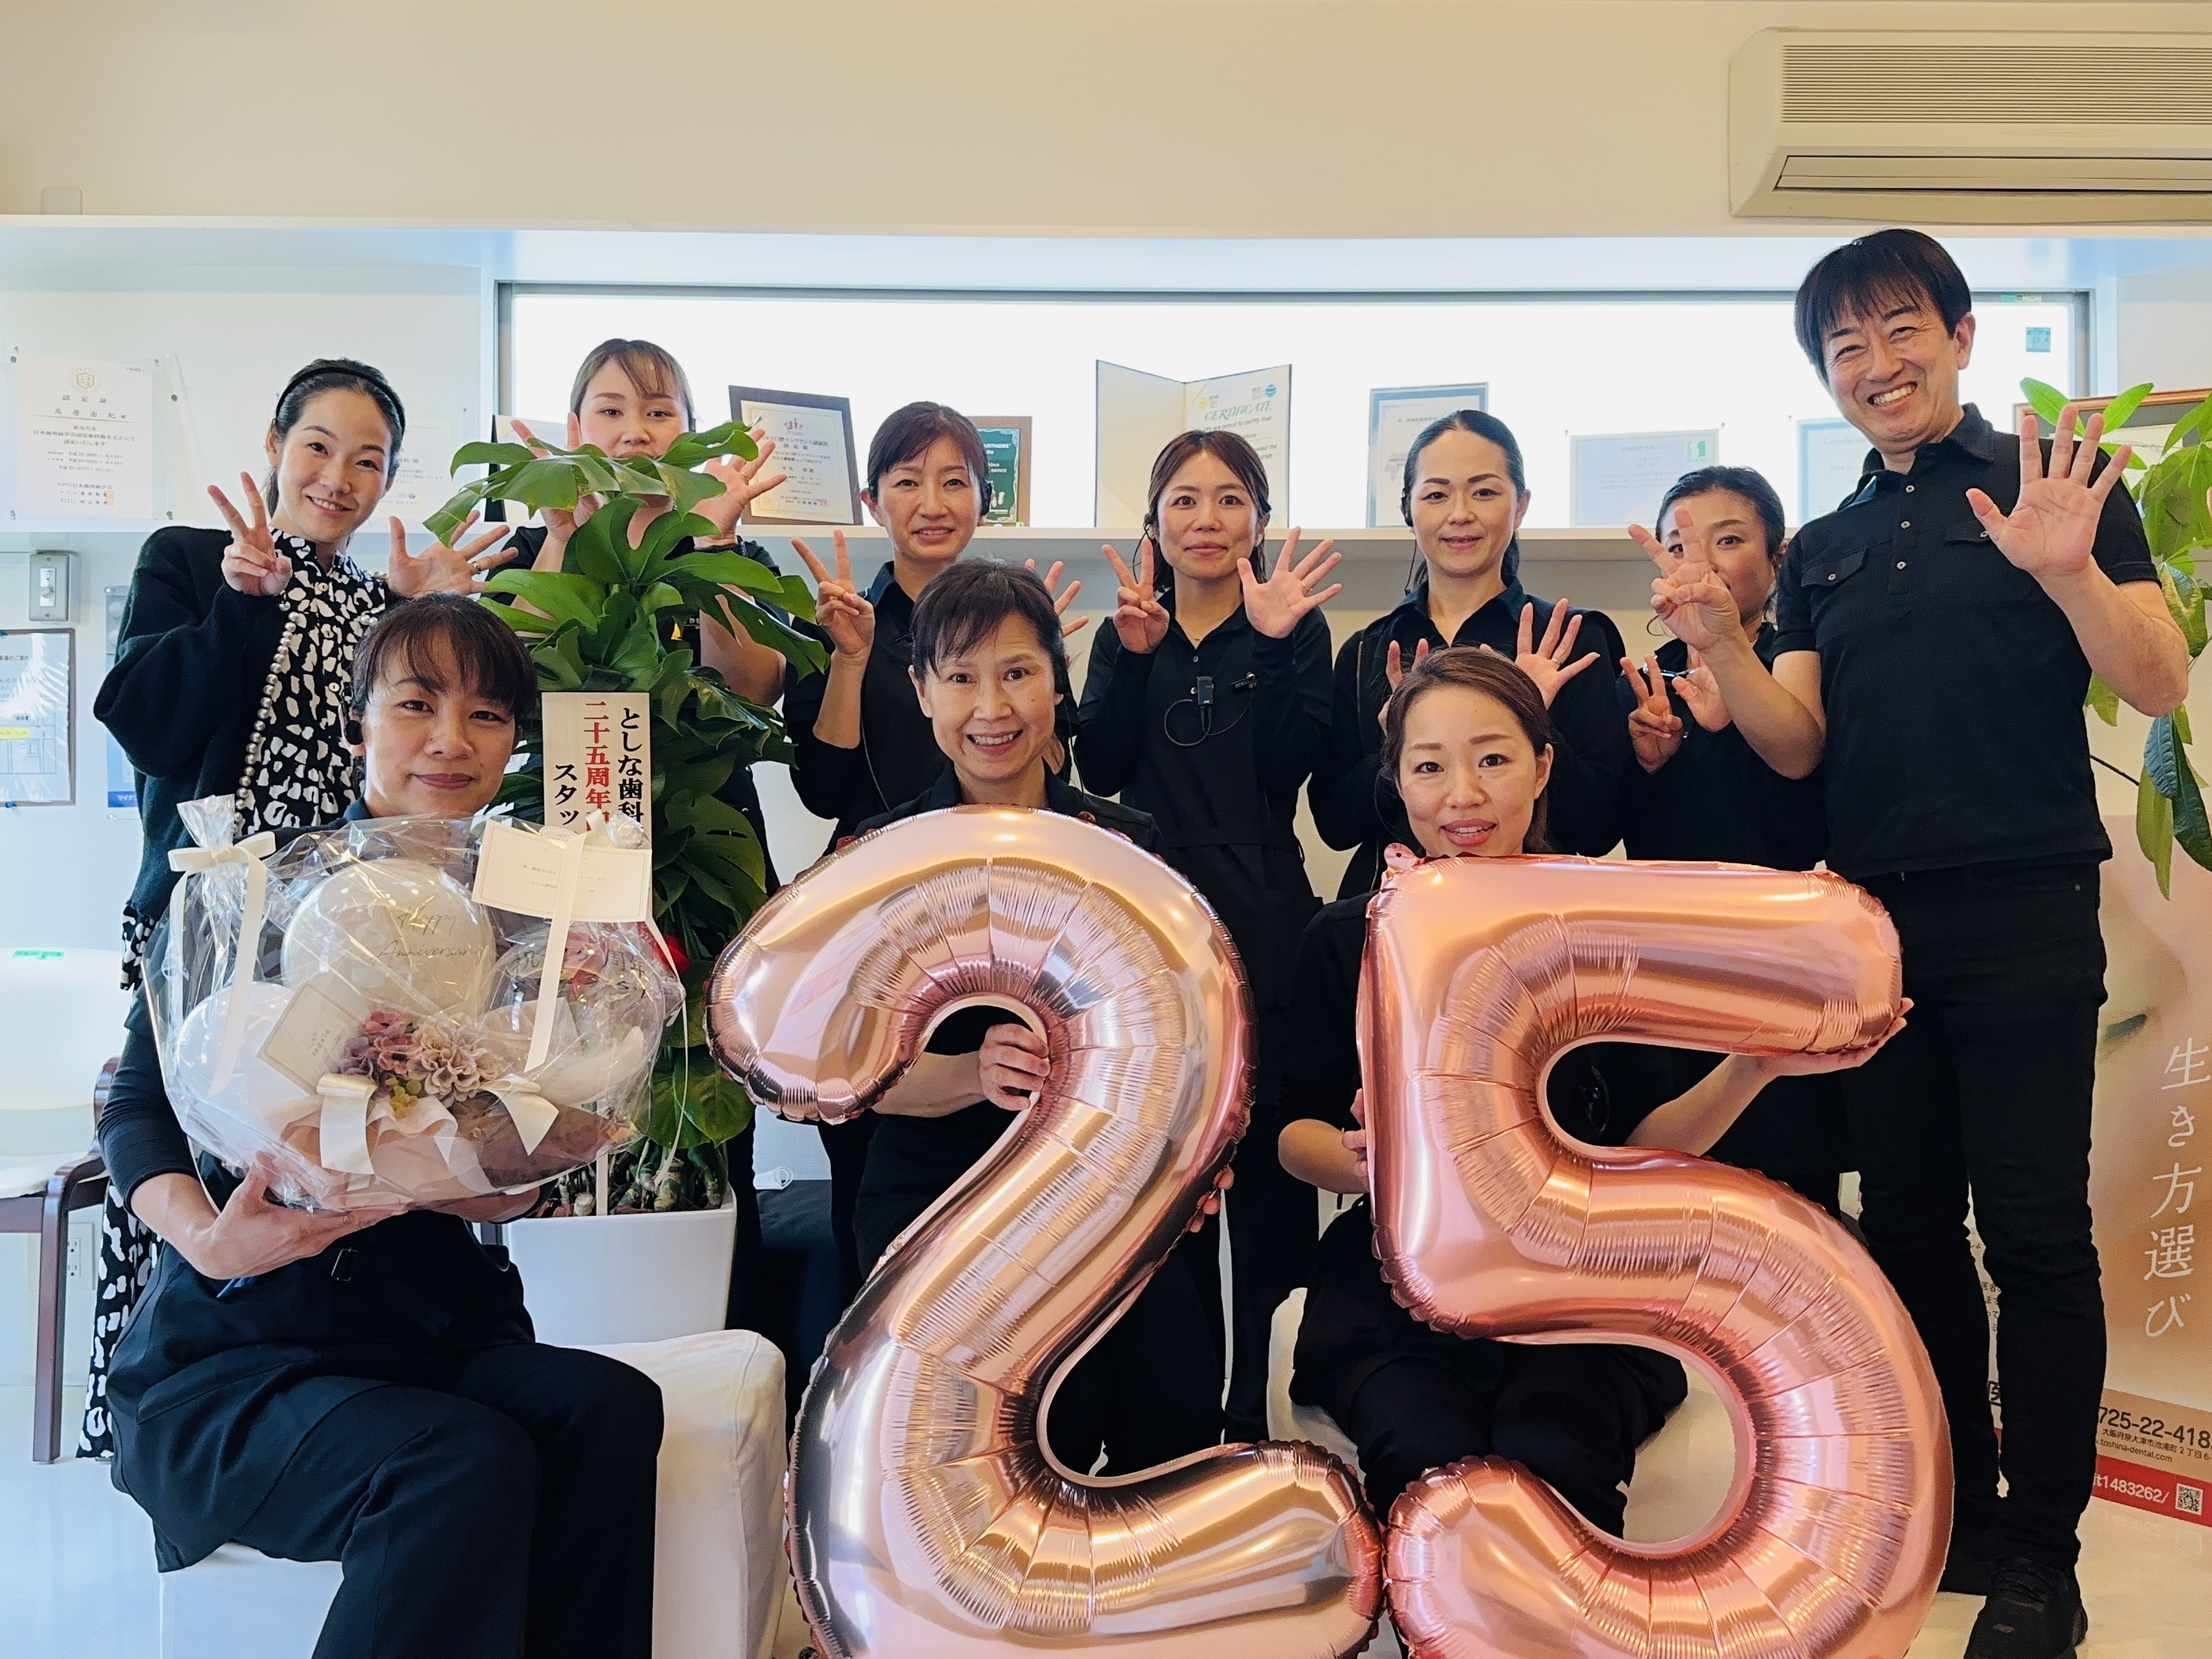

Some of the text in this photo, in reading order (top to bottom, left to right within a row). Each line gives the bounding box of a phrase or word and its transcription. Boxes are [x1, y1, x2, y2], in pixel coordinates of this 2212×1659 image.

[1204, 400, 1272, 421] CERTIFICATE
[1244, 417, 1260, 426] certify
[397, 905, 457, 936] Happy
[377, 939, 478, 970] Anniversary
[312, 1029, 330, 1056] regalo
[2143, 1037, 2211, 1338] 生き方選び
[2099, 1406, 2212, 1448] 725-22-418
